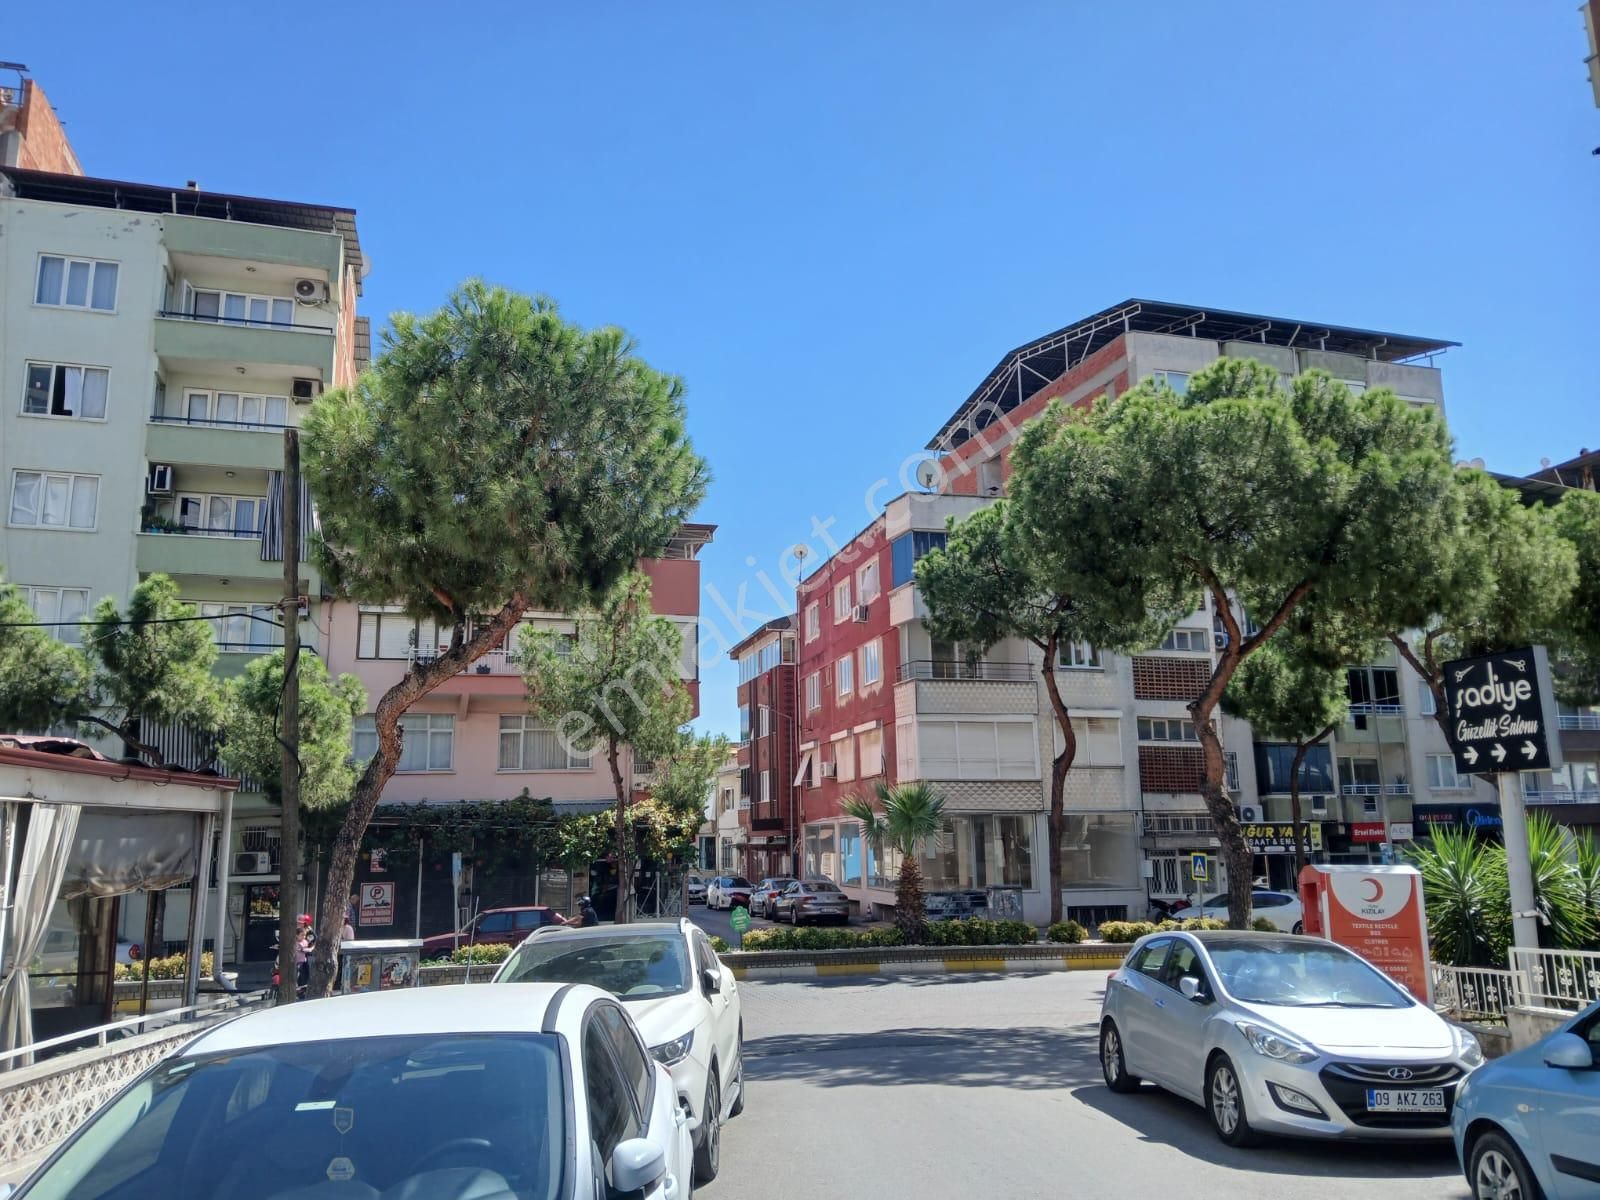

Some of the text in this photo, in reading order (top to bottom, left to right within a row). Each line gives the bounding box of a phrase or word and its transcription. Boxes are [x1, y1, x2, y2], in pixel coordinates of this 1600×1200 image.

[1457, 713, 1538, 742] Güzellik Salonu
[1280, 838, 1308, 846] EMLK
[1375, 1092, 1443, 1106] 09 AKZ 263
